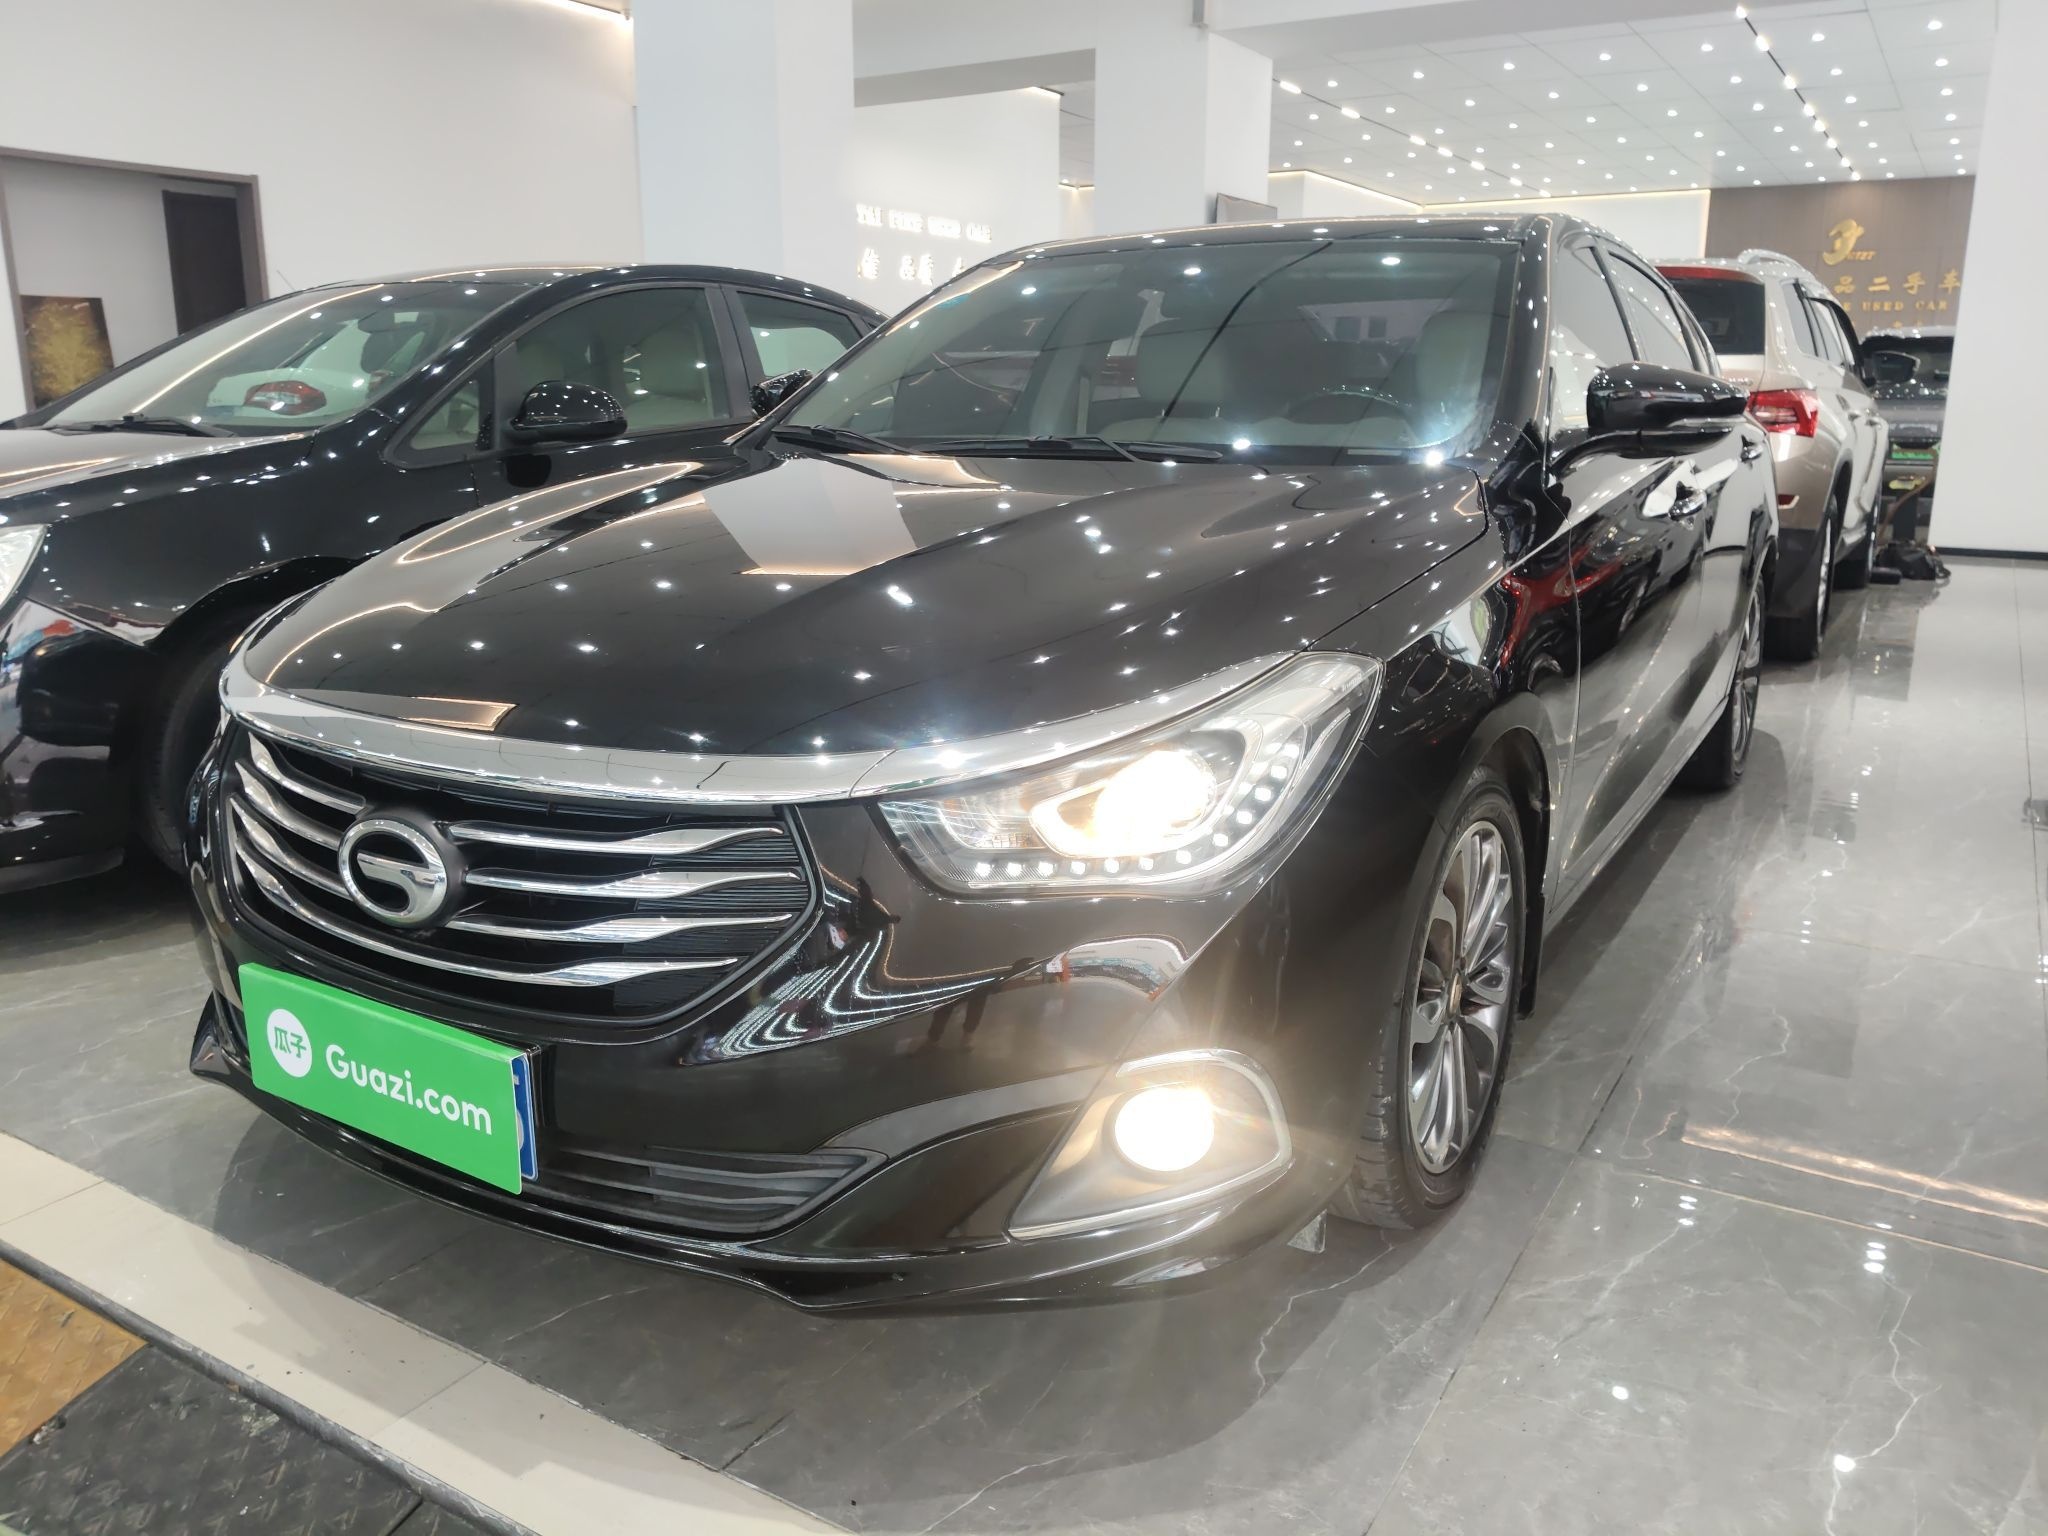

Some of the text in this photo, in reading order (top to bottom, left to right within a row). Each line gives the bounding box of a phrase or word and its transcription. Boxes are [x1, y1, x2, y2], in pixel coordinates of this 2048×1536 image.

[1862, 301, 1904, 312] USED
[1915, 300, 1948, 311] CAR
[274, 1026, 307, 1058] 瓜子
[325, 1044, 492, 1136] Guazi.com
